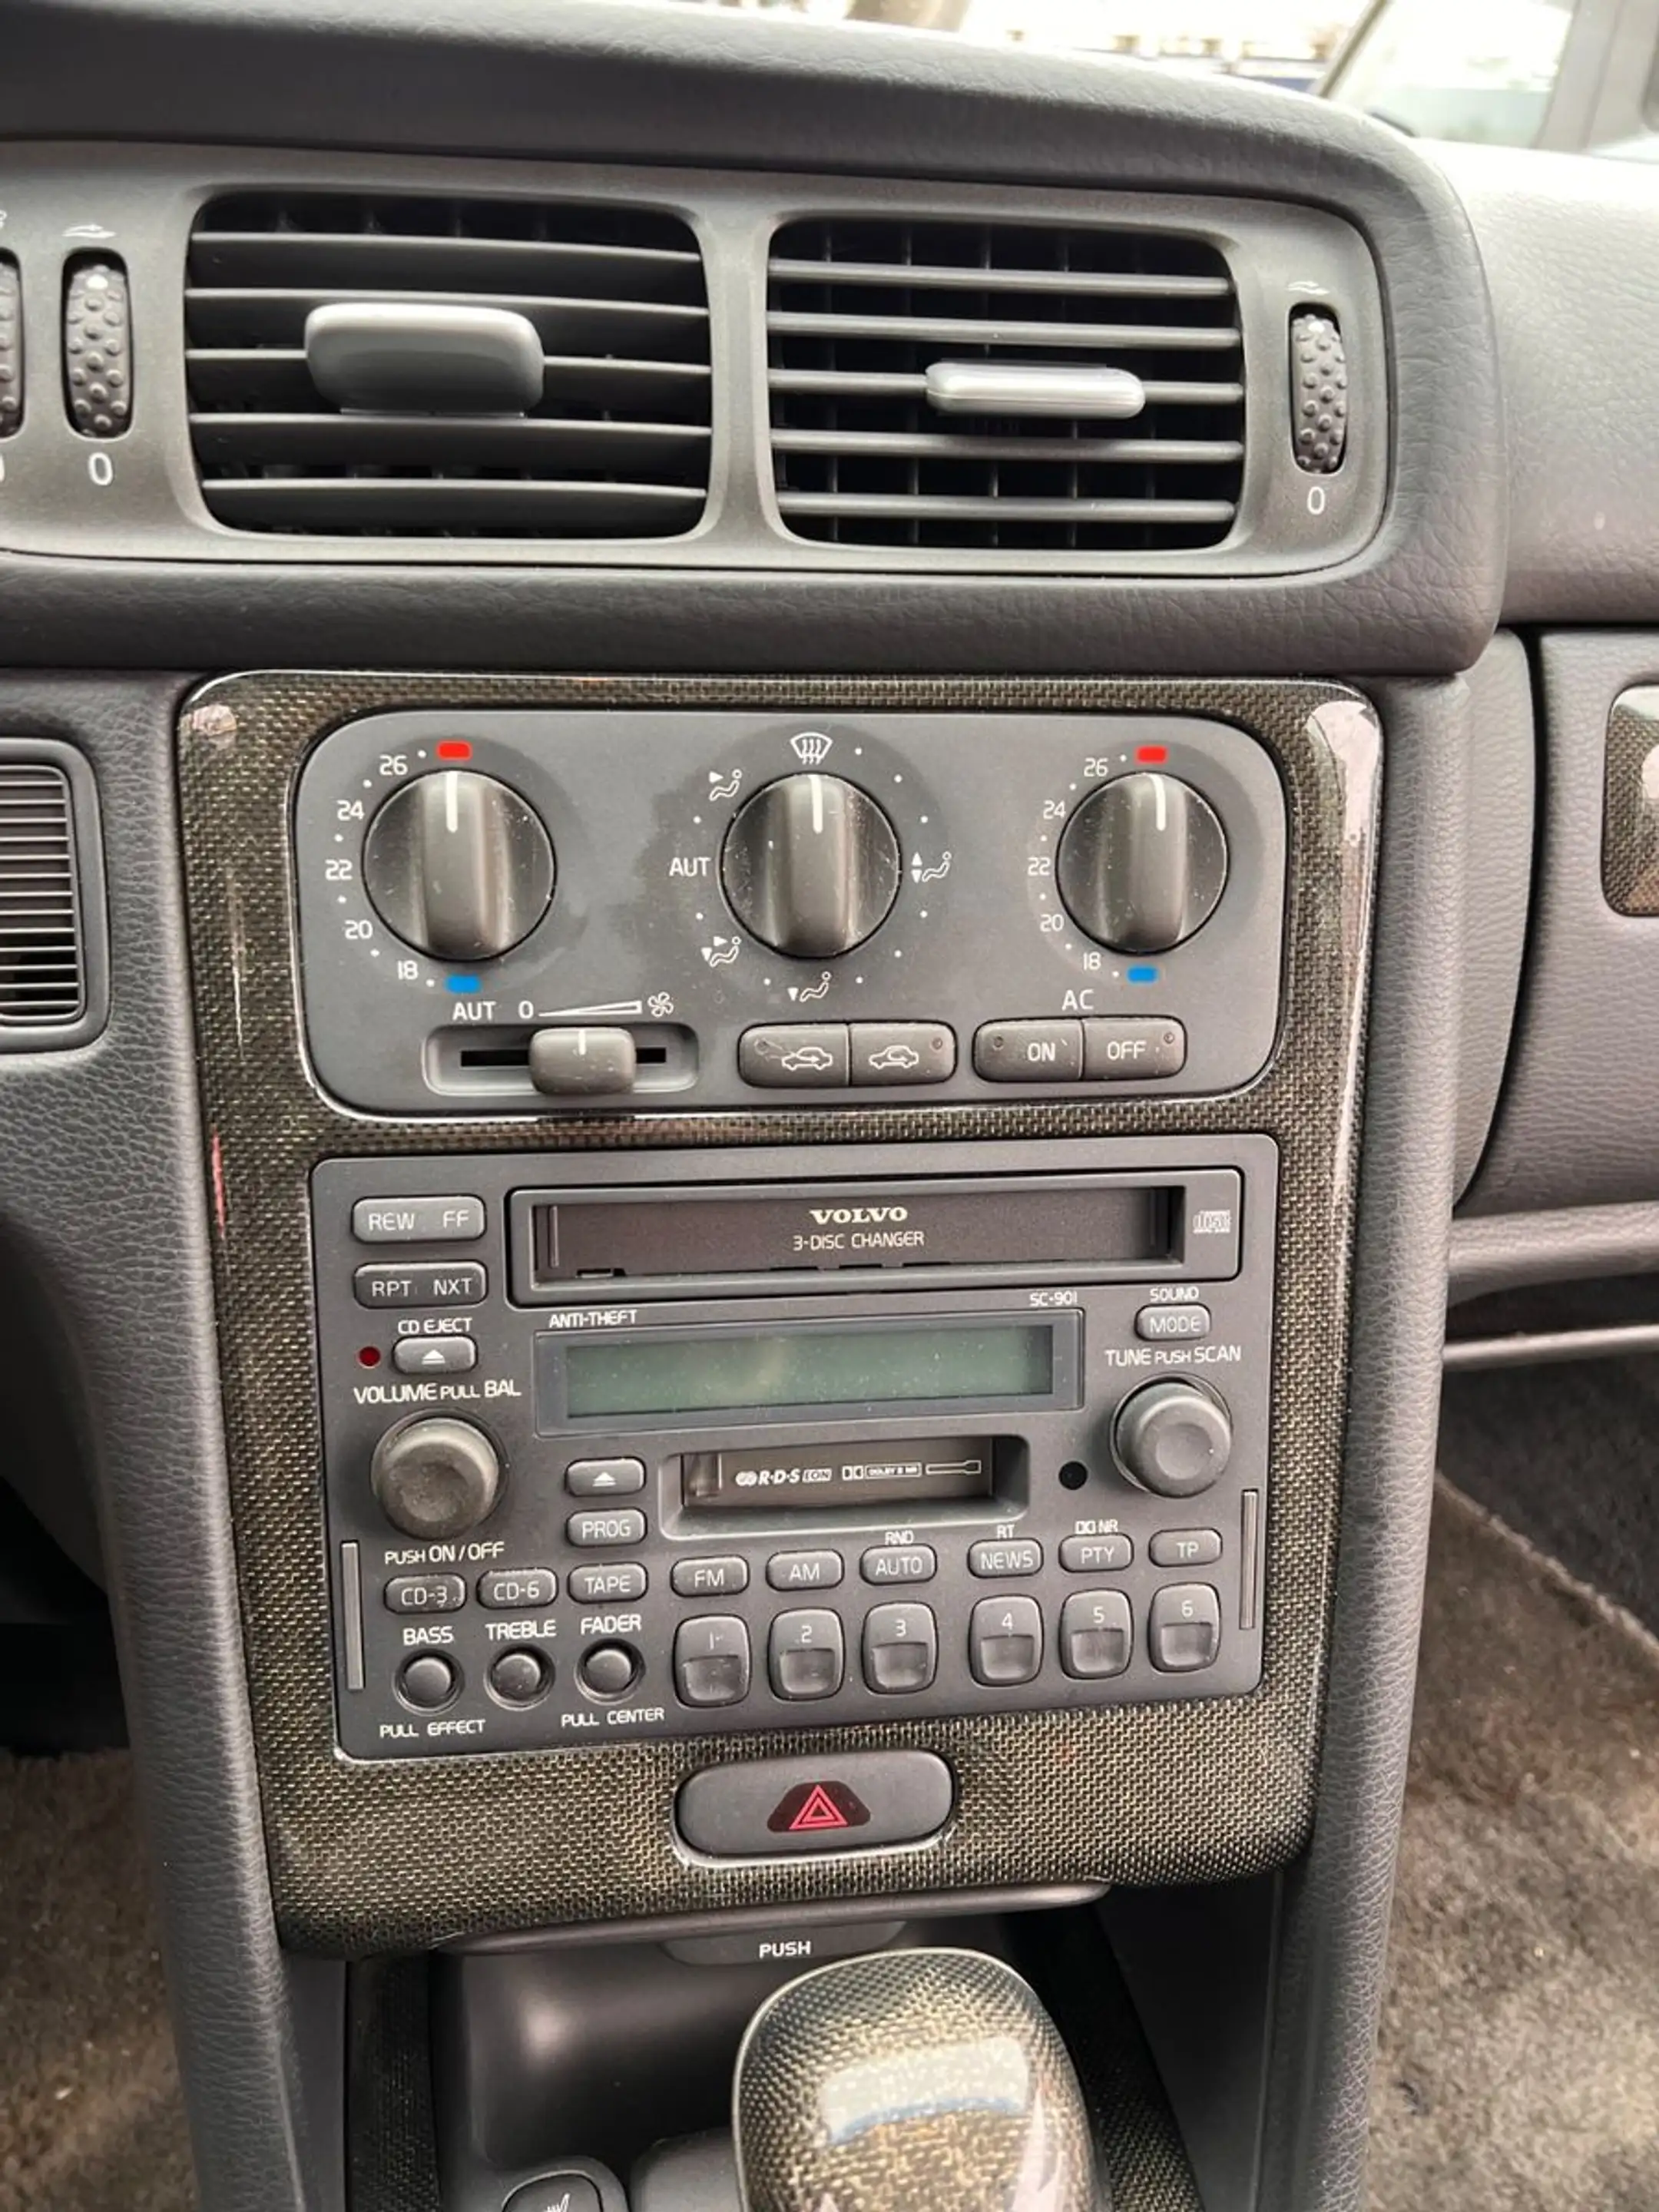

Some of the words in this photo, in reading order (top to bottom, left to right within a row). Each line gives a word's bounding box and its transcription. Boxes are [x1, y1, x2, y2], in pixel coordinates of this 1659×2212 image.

[88, 452, 113, 486] 0
[1307, 485, 1326, 515] 0
[379, 755, 408, 776] 26
[1084, 758, 1108, 777] 26
[336, 800, 365, 820] 24
[1043, 800, 1066, 820] 24
[325, 860, 353, 880] 22
[669, 856, 711, 877] AUT
[1027, 858, 1051, 876] 22
[344, 920, 373, 939] 20
[1040, 915, 1065, 932] 20
[397, 961, 419, 980] 18
[1083, 952, 1101, 970] 18
[1061, 989, 1094, 1011] AC
[452, 1001, 496, 1022] AUT
[1028, 1042, 1056, 1062] ON
[1107, 1041, 1147, 1060] OFF
[369, 1212, 416, 1231] REW
[443, 1210, 470, 1228] FF
[809, 1206, 908, 1225] VOLVO
[792, 1233, 845, 1251] 3-DISC
[851, 1230, 925, 1249] CHANGER
[372, 1280, 412, 1297] RPT
[433, 1278, 474, 1295] NXT
[1150, 1286, 1200, 1302] SOUND
[398, 1319, 419, 1335] CD
[424, 1317, 473, 1333] EJECT
[549, 1309, 638, 1329] ANTI-THEFT
[1149, 1315, 1202, 1333] MODE
[1104, 1348, 1152, 1367] TUNE
[1154, 1350, 1191, 1365] PUSH
[1194, 1344, 1243, 1363] SCAN
[353, 1382, 439, 1404] VOLUME
[440, 1384, 481, 1400] PULL
[485, 1379, 522, 1398] BAL
[581, 1519, 631, 1539] PROG
[884, 1529, 914, 1546] RND
[997, 1525, 1015, 1539] RT
[385, 1549, 426, 1565] PUSH
[1081, 1546, 1115, 1565] PTY
[1176, 1541, 1200, 1558] TP
[875, 1557, 922, 1576] AUTO
[981, 1550, 1034, 1569] NEWS
[694, 1568, 725, 1588] FM
[789, 1563, 820, 1581] AM
[493, 1581, 540, 1601] CD-6
[584, 1576, 632, 1595] TAPE
[401, 1585, 448, 1606] CD-3
[1092, 1606, 1104, 1624] 5
[1181, 1600, 1194, 1618] 6
[485, 1619, 557, 1641] TREBLE
[580, 1614, 642, 1635] FADER
[894, 1619, 907, 1637] 3
[1002, 1613, 1013, 1630] 4
[402, 1626, 455, 1646] BASS
[800, 1625, 813, 1643] 2
[561, 1713, 599, 1728] PULL
[607, 1707, 664, 1724] CENTER
[379, 1724, 419, 1739] PULL
[427, 1719, 485, 1737] EFFECT
[759, 1940, 811, 1959] PUSH
